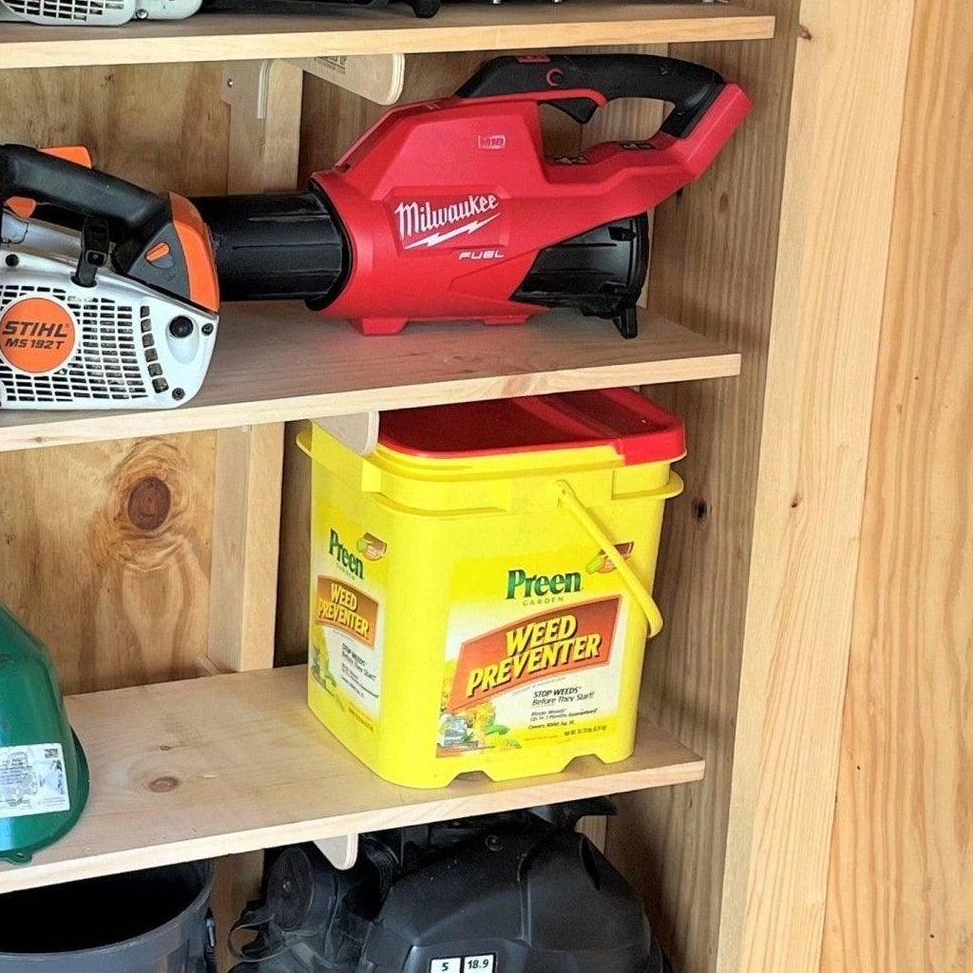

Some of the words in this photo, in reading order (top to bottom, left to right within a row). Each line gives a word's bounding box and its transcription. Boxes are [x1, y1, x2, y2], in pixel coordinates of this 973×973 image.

[395, 194, 499, 239] Milwaukee
[458, 250, 505, 260] FUEL
[2, 321, 69, 338] STIHL
[5, 337, 29, 348] MS
[329, 527, 365, 580] Preen
[506, 569, 582, 600] Preen
[330, 583, 358, 612] WEED
[523, 596, 565, 607] GARDEN
[319, 599, 370, 639] PREVENTER
[506, 615, 577, 652] WEED
[467, 633, 602, 699] PREVENTER
[531, 697, 557, 707] Before
[557, 695, 575, 703] They
[533, 689, 553, 699] STOP
[441, 961, 449, 973] 5
[467, 958, 489, 971] 18.9
